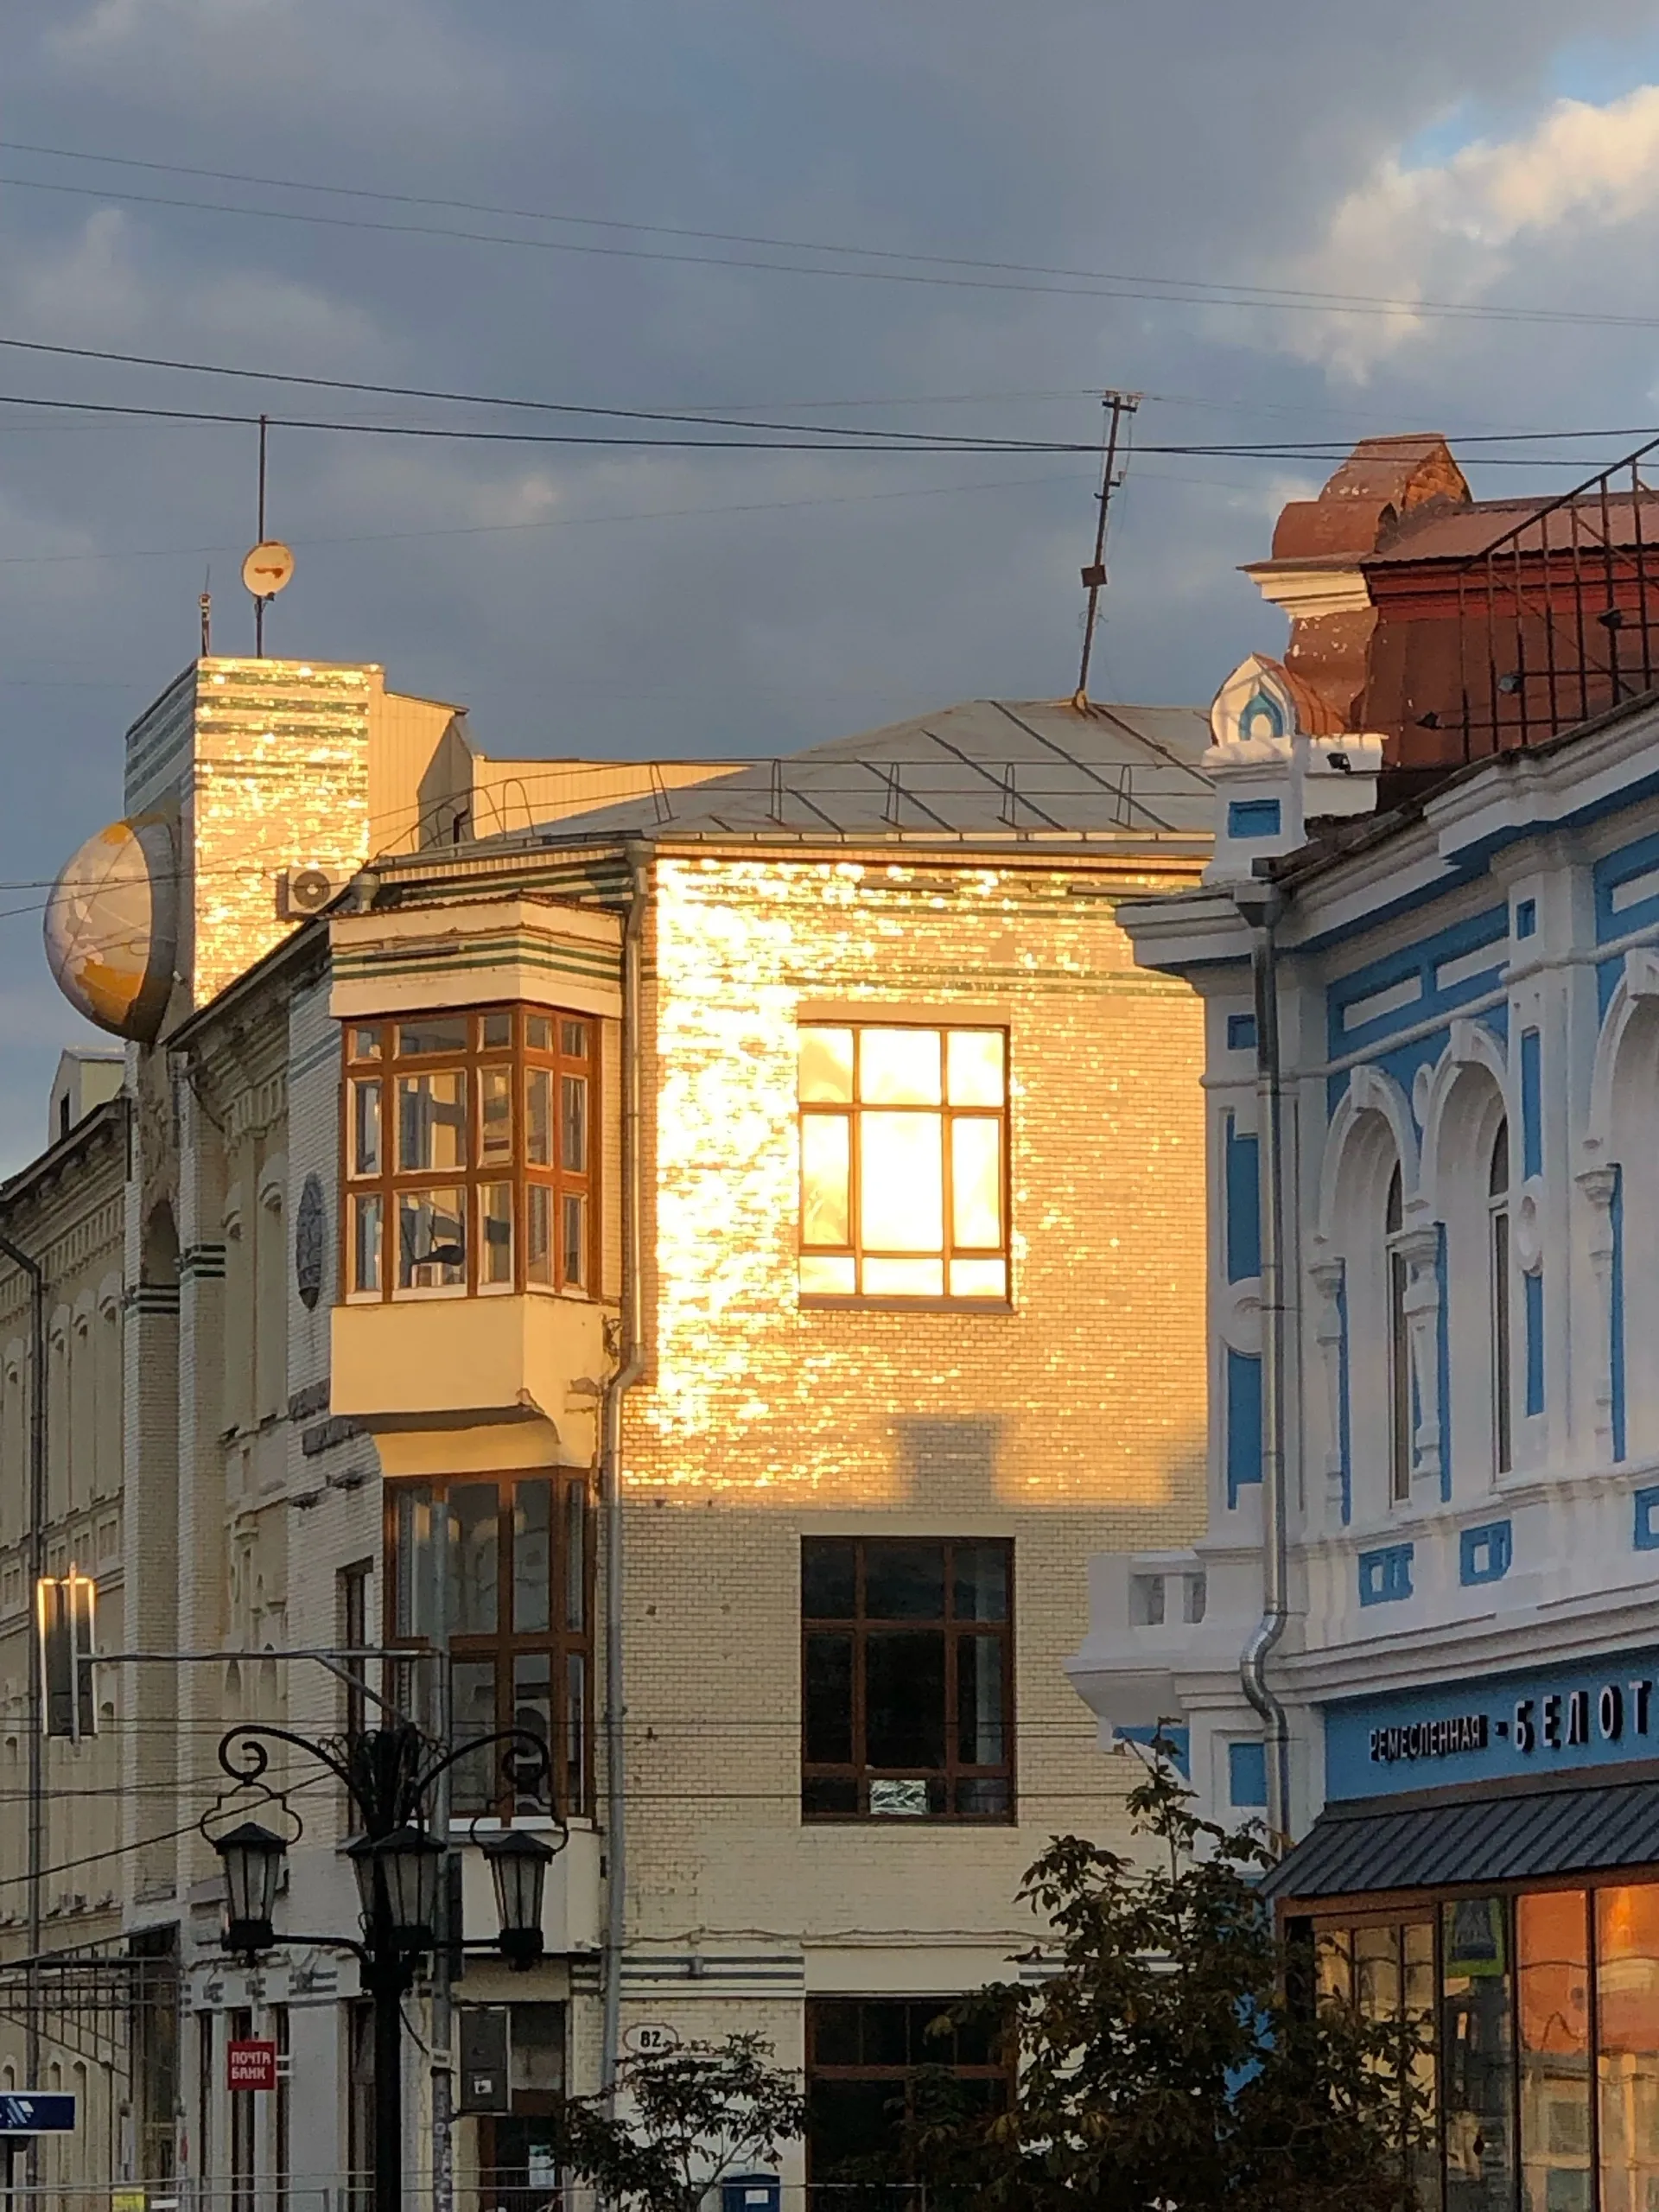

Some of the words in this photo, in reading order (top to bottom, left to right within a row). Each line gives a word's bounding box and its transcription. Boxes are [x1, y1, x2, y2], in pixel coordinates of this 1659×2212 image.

[1369, 1715, 1486, 1762] РЕМЕСЛЕННАЯ
[1514, 1679, 1659, 1752] БЕЛОТ
[640, 2031, 663, 2048] 82
[232, 2051, 271, 2065] ПОЧТА
[232, 2067, 266, 2080] БАНК
